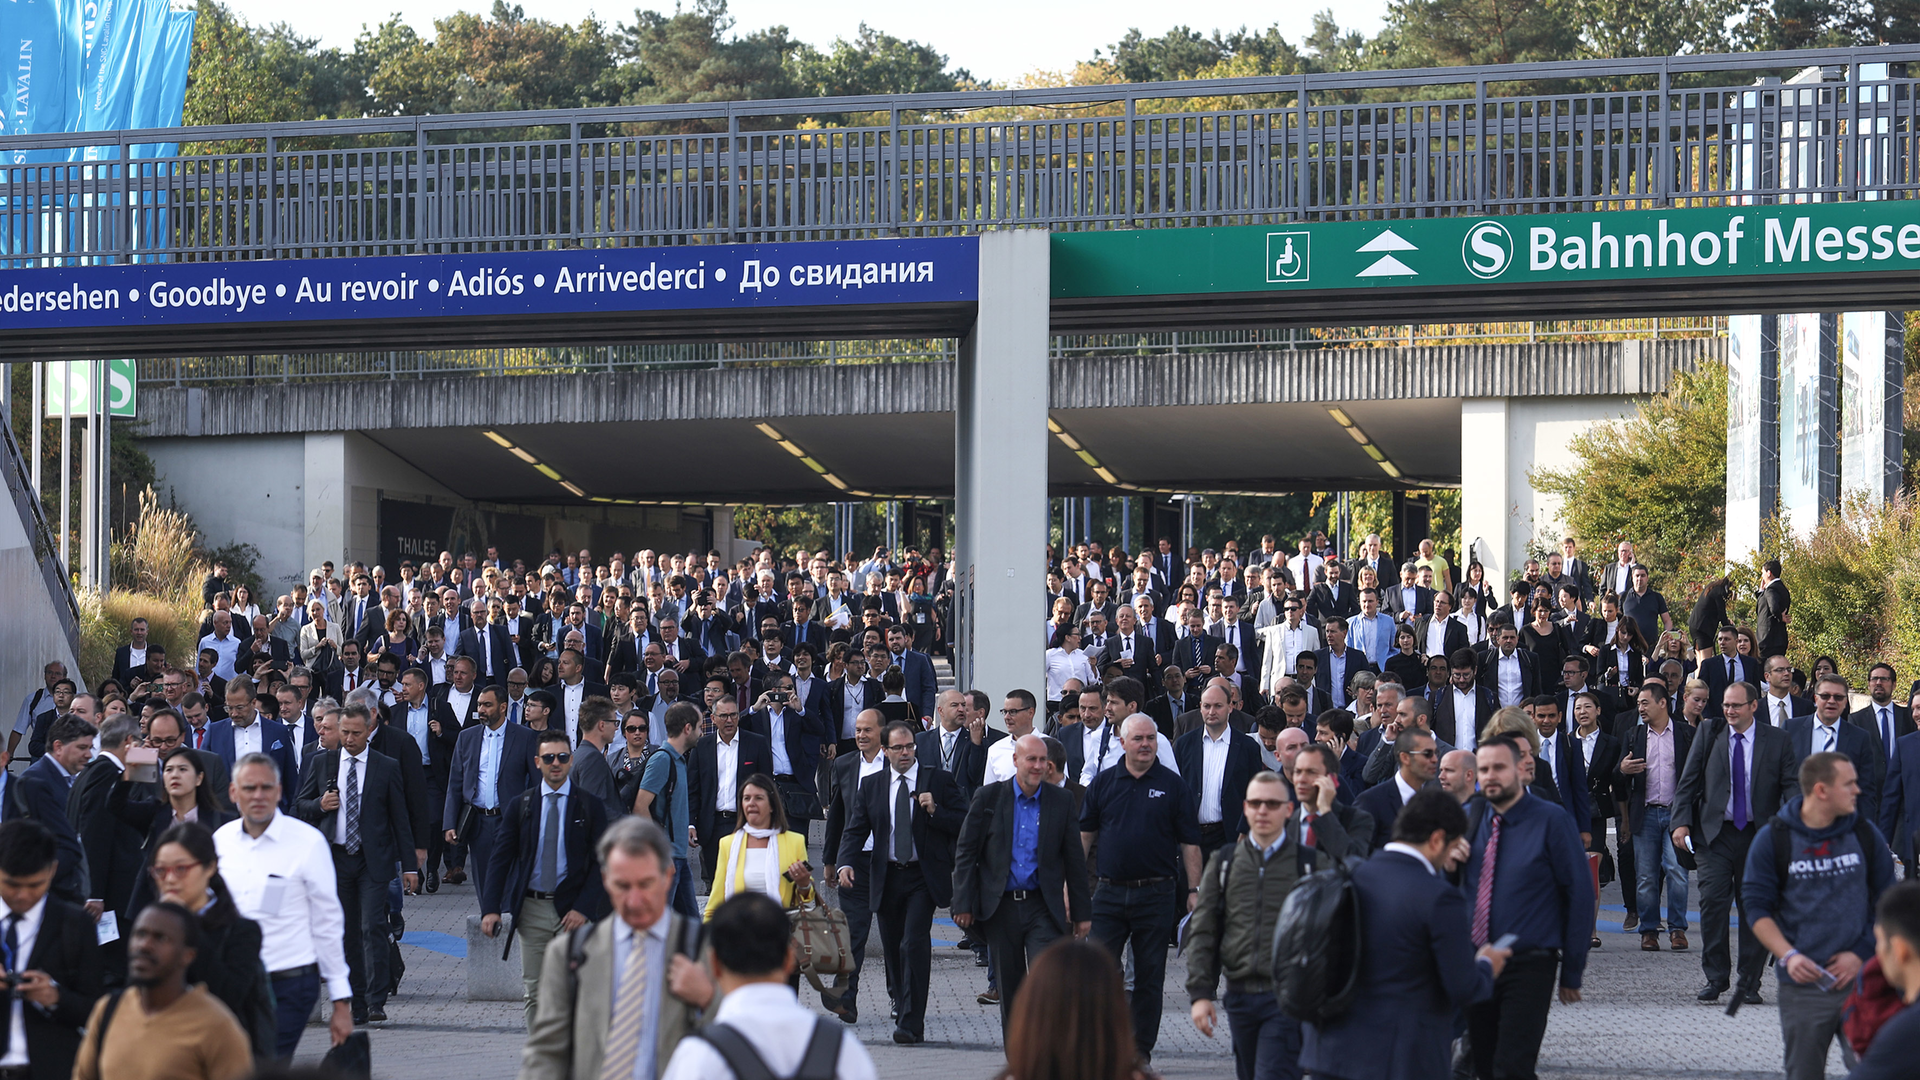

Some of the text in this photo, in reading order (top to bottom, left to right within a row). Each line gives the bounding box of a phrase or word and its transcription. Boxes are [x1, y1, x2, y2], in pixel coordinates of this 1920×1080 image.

[94, 83, 103, 111] Member
[104, 1, 113, 22] Group
[1529, 215, 1745, 272] Bahnhof
[1764, 215, 1920, 264] Messe
[0, 260, 705, 313] dersehen Goodbye Au revoir Adiós Arrivederci
[739, 259, 934, 294] До свидания
[397, 536, 436, 557] THALES
